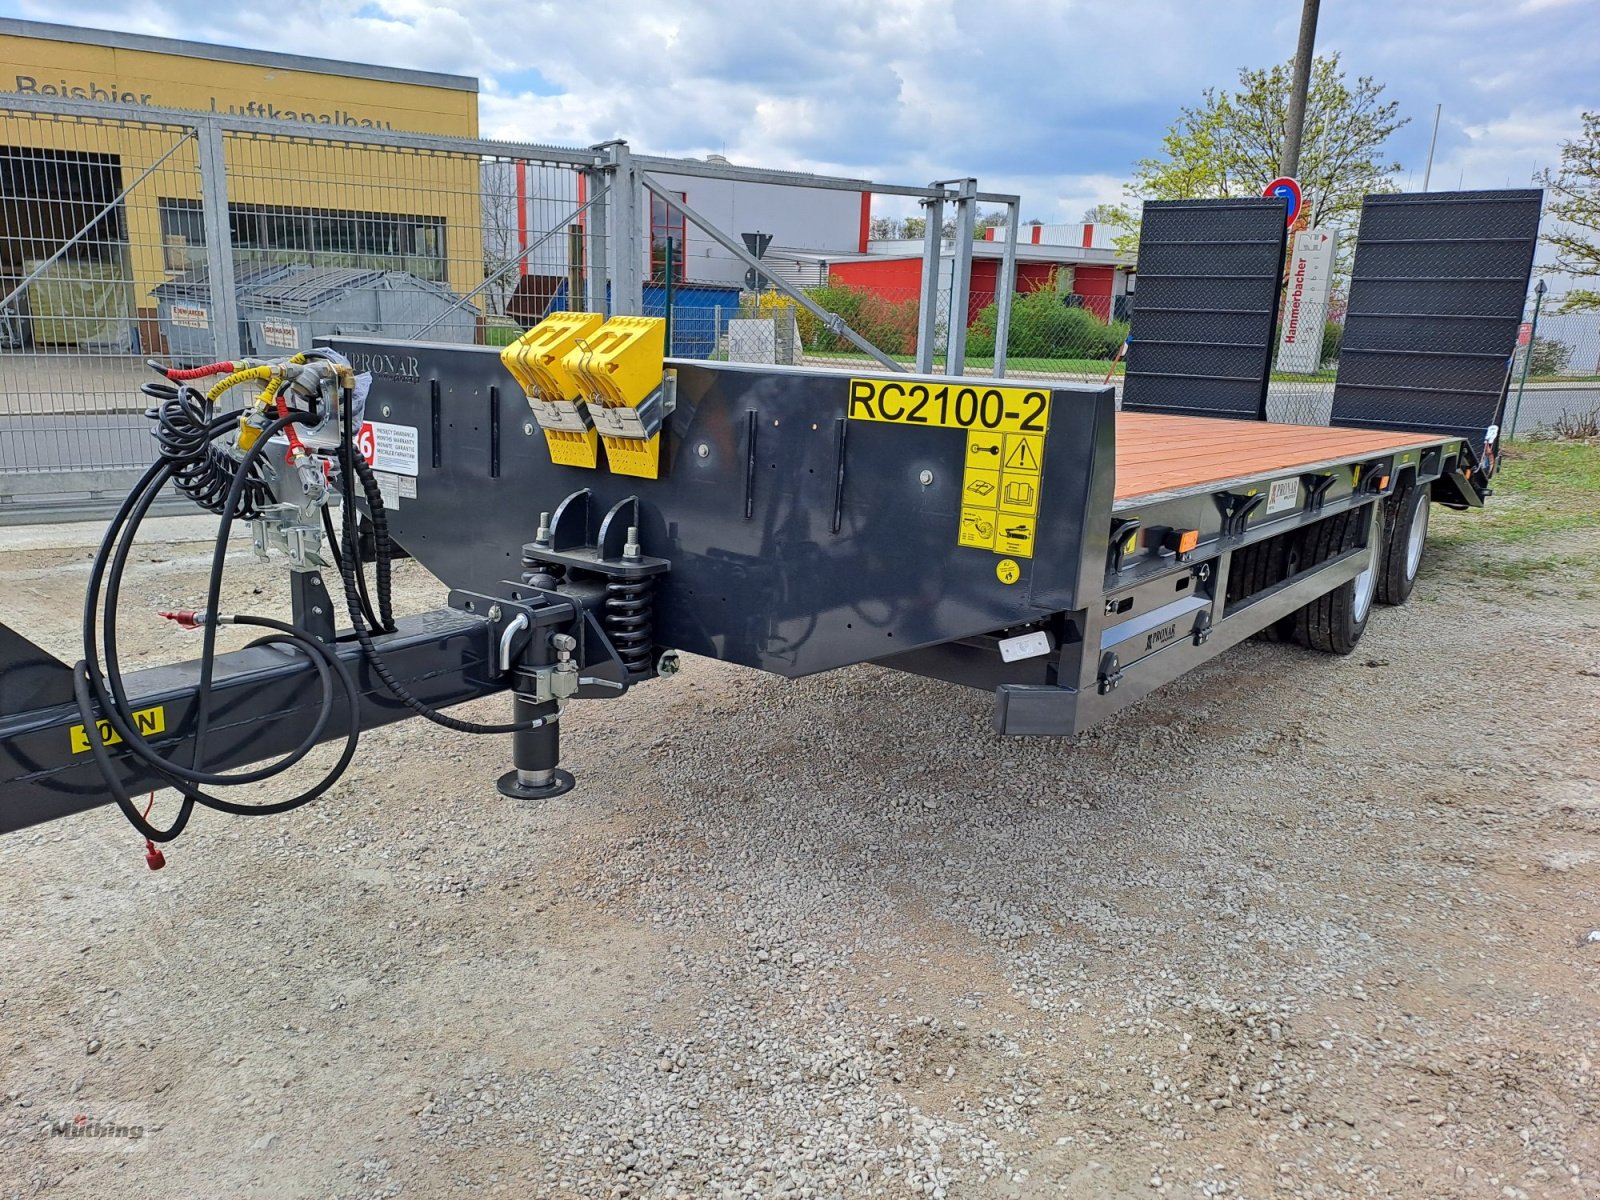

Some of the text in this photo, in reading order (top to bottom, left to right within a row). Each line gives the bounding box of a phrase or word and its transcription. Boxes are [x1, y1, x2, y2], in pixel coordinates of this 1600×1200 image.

[1285, 257, 1307, 344] Hammerbacher
[352, 352, 420, 377] PRONAR
[849, 381, 1047, 432] RC2100-2
[1276, 481, 1298, 497] PRONAR
[1152, 624, 1176, 643] PRONAR
